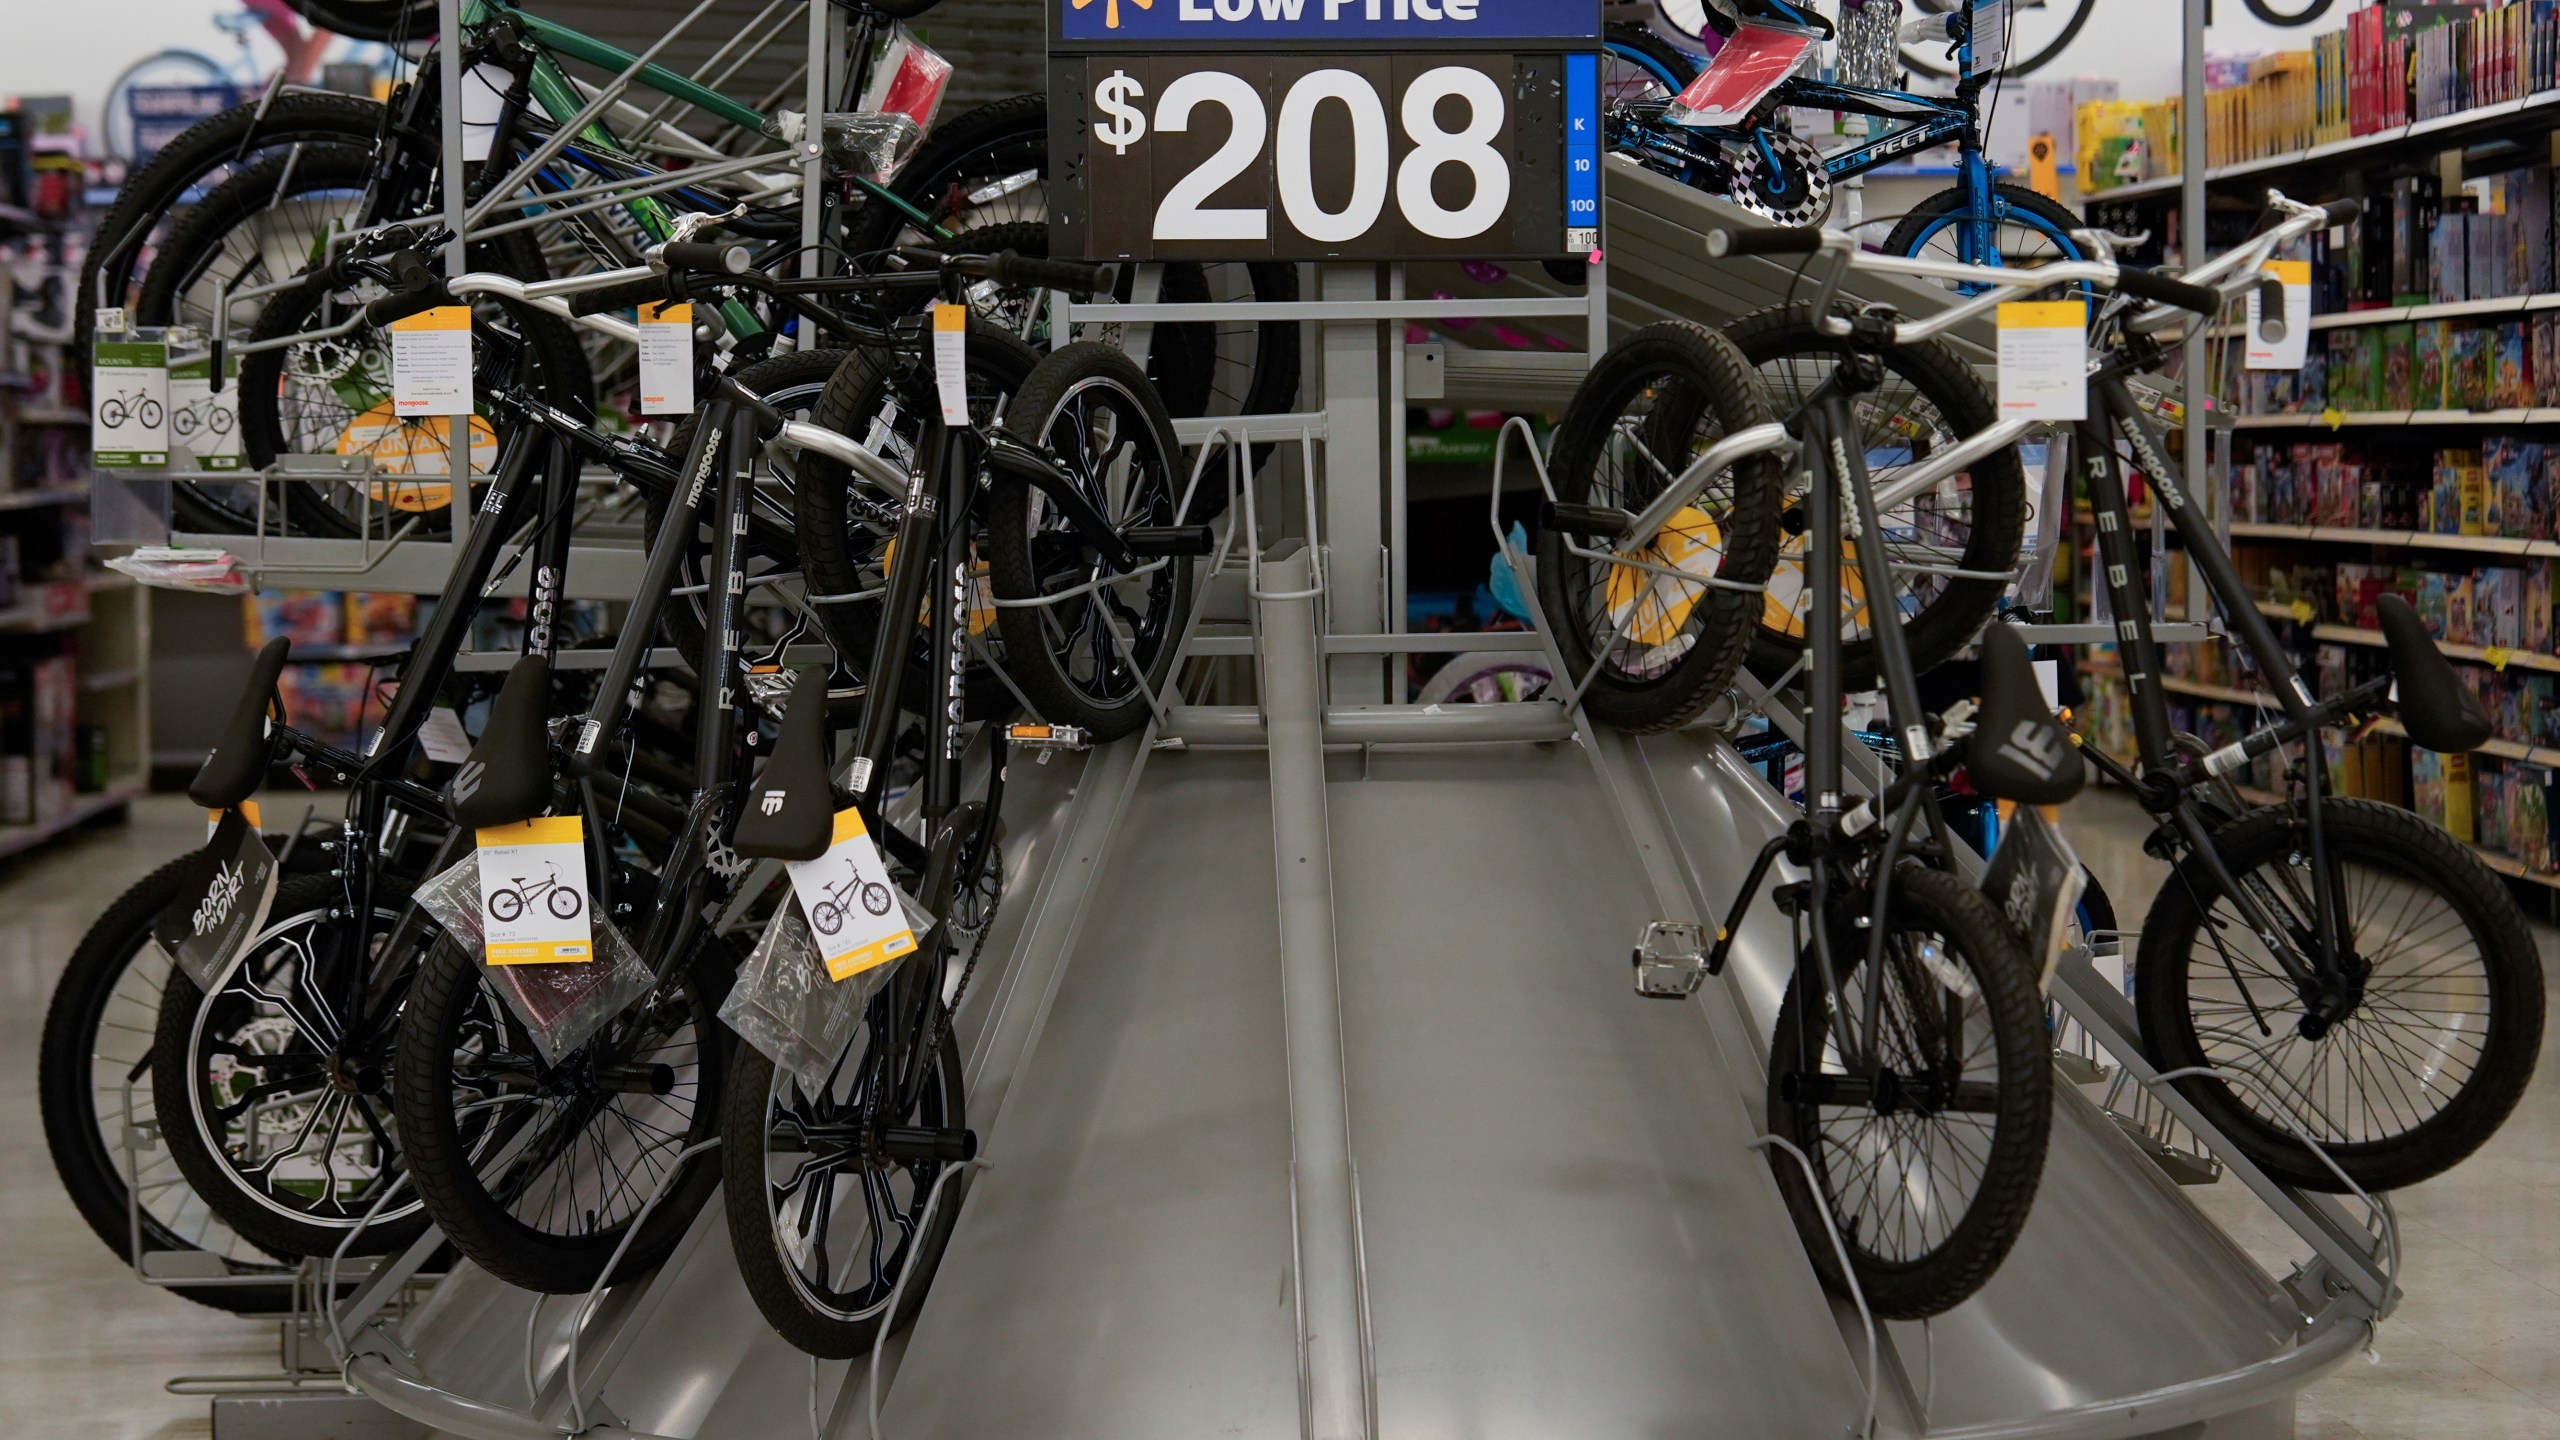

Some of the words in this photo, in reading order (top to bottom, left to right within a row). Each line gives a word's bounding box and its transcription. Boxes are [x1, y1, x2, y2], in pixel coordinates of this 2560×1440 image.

[1574, 118, 1585, 130] K
[1574, 159, 1590, 171] 10
[1571, 199, 1595, 213] 100
[1579, 232, 1598, 244] 100
[686, 428, 723, 509] mongoose
[2120, 416, 2184, 510] mongoose
[192, 859, 230, 937] BORN
[206, 910, 218, 934] IN
[217, 860, 245, 926] DIRT
